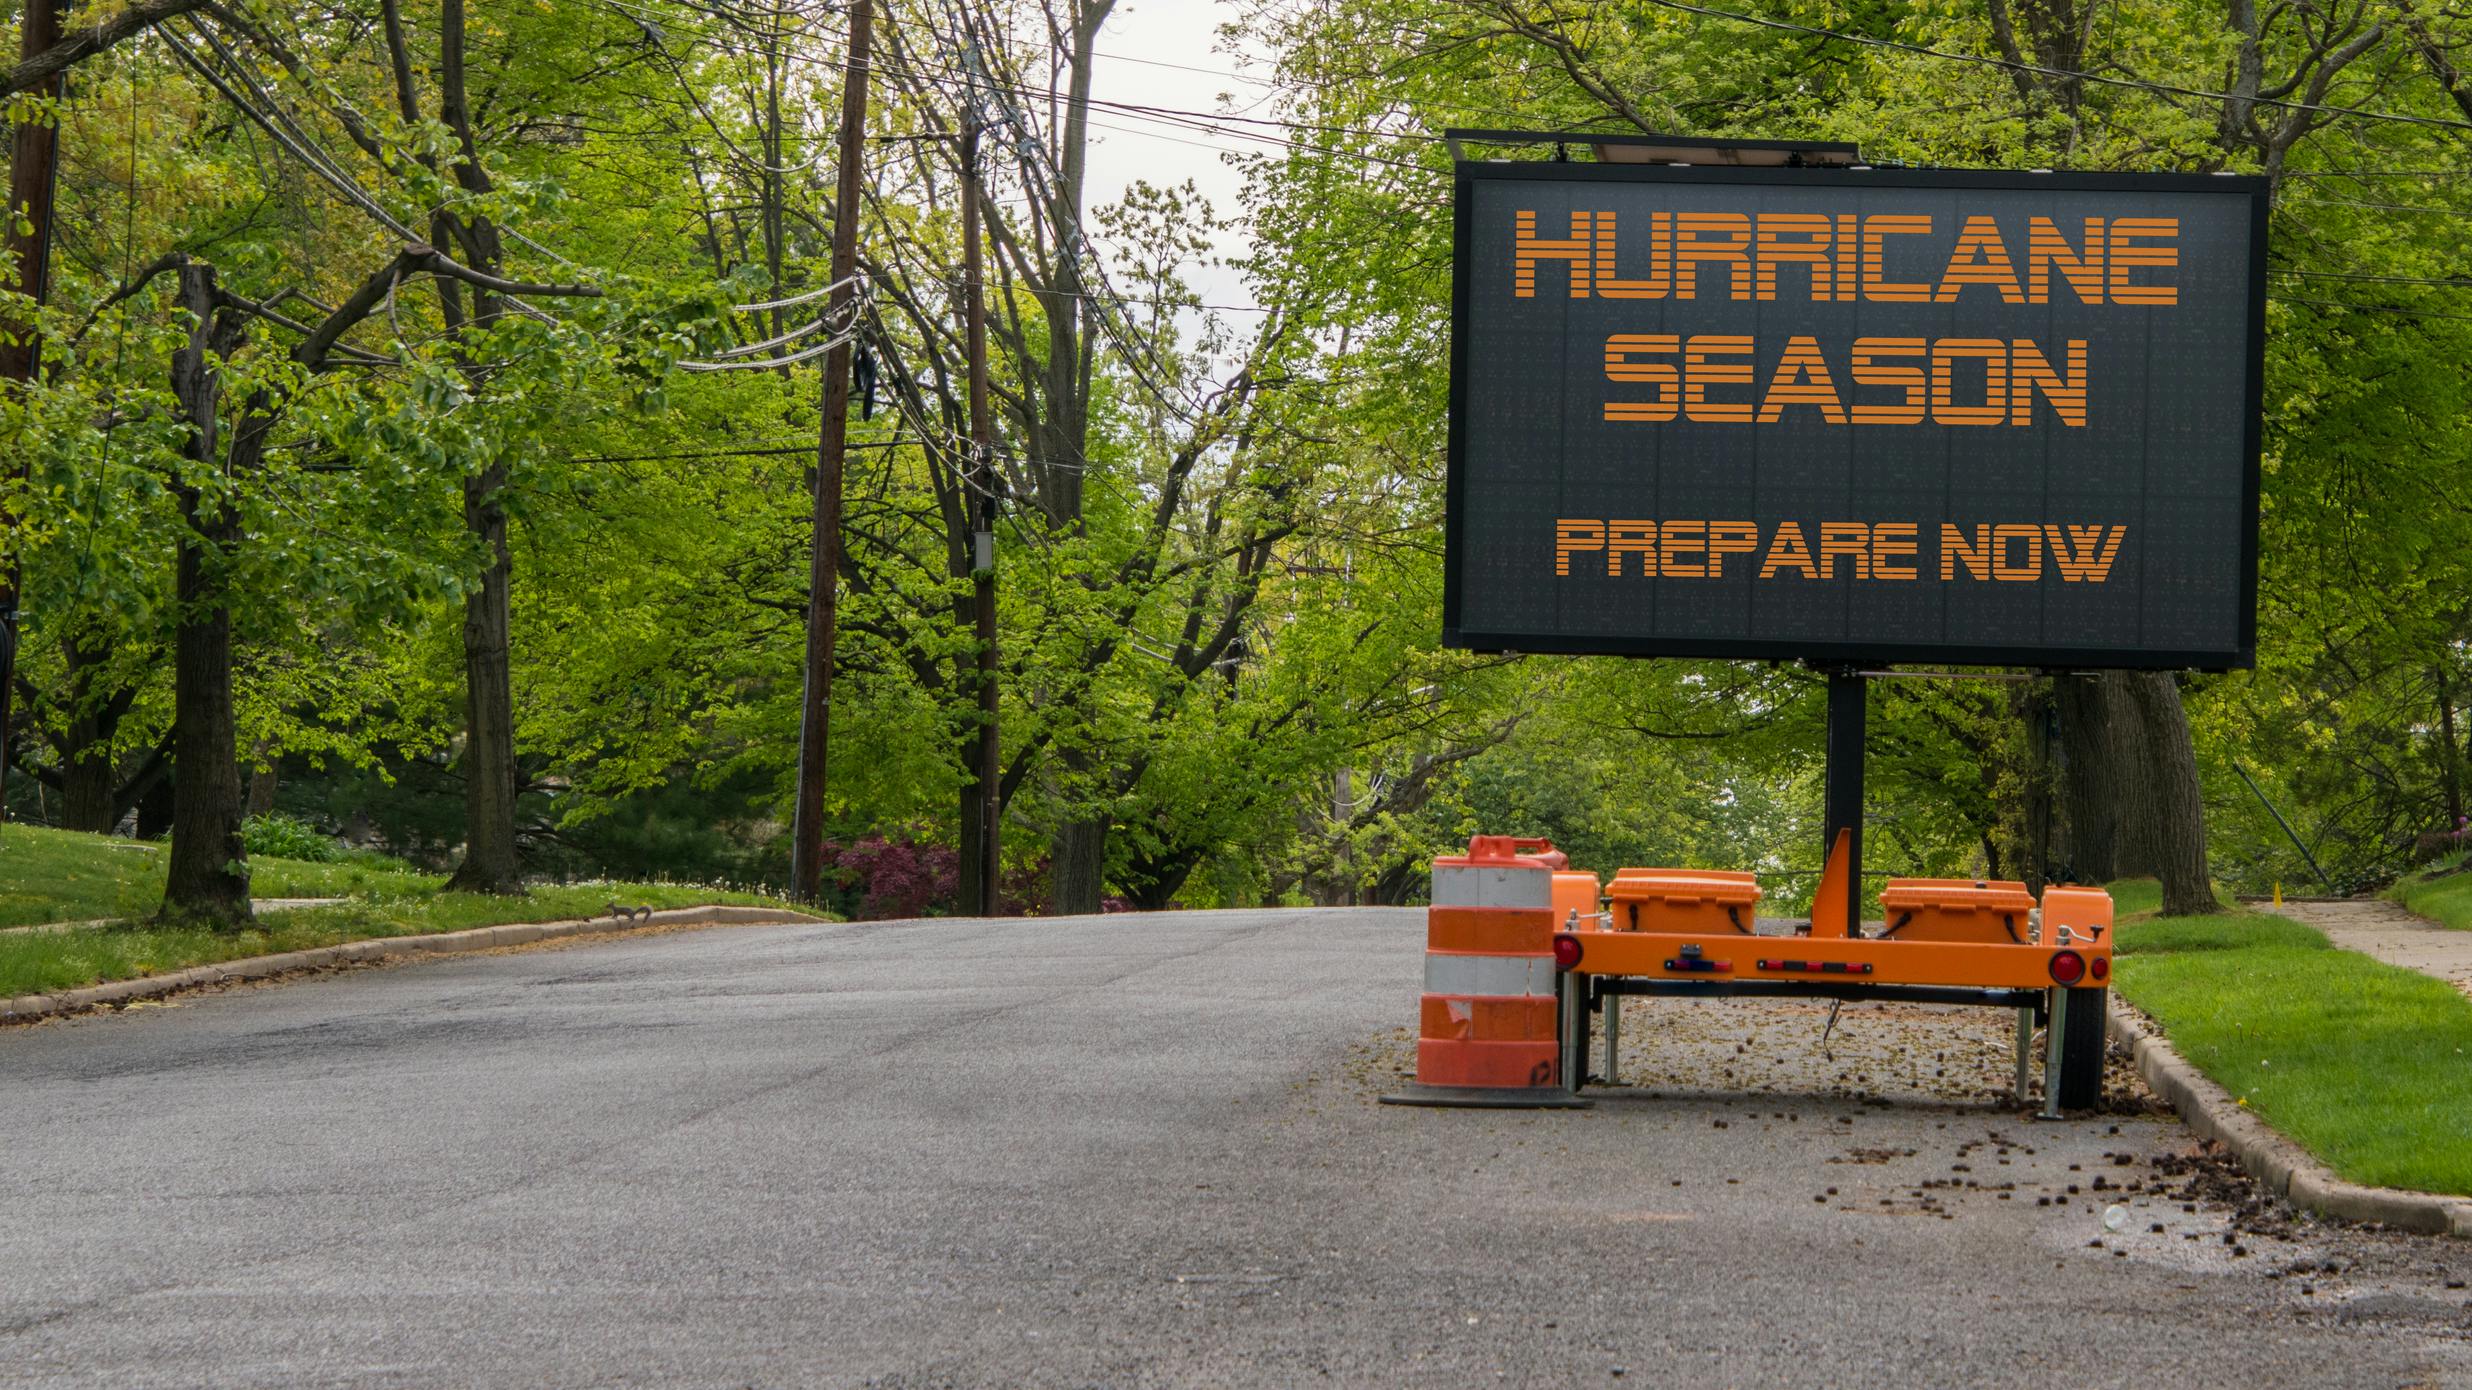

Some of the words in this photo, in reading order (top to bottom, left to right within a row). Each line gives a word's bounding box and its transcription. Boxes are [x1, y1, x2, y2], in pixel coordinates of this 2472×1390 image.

[1516, 211, 2178, 305] HURRICANE
[1604, 335, 2087, 426] SEASON
[1557, 519, 1917, 580] PREPARE
[1941, 524, 2126, 582] NOW
